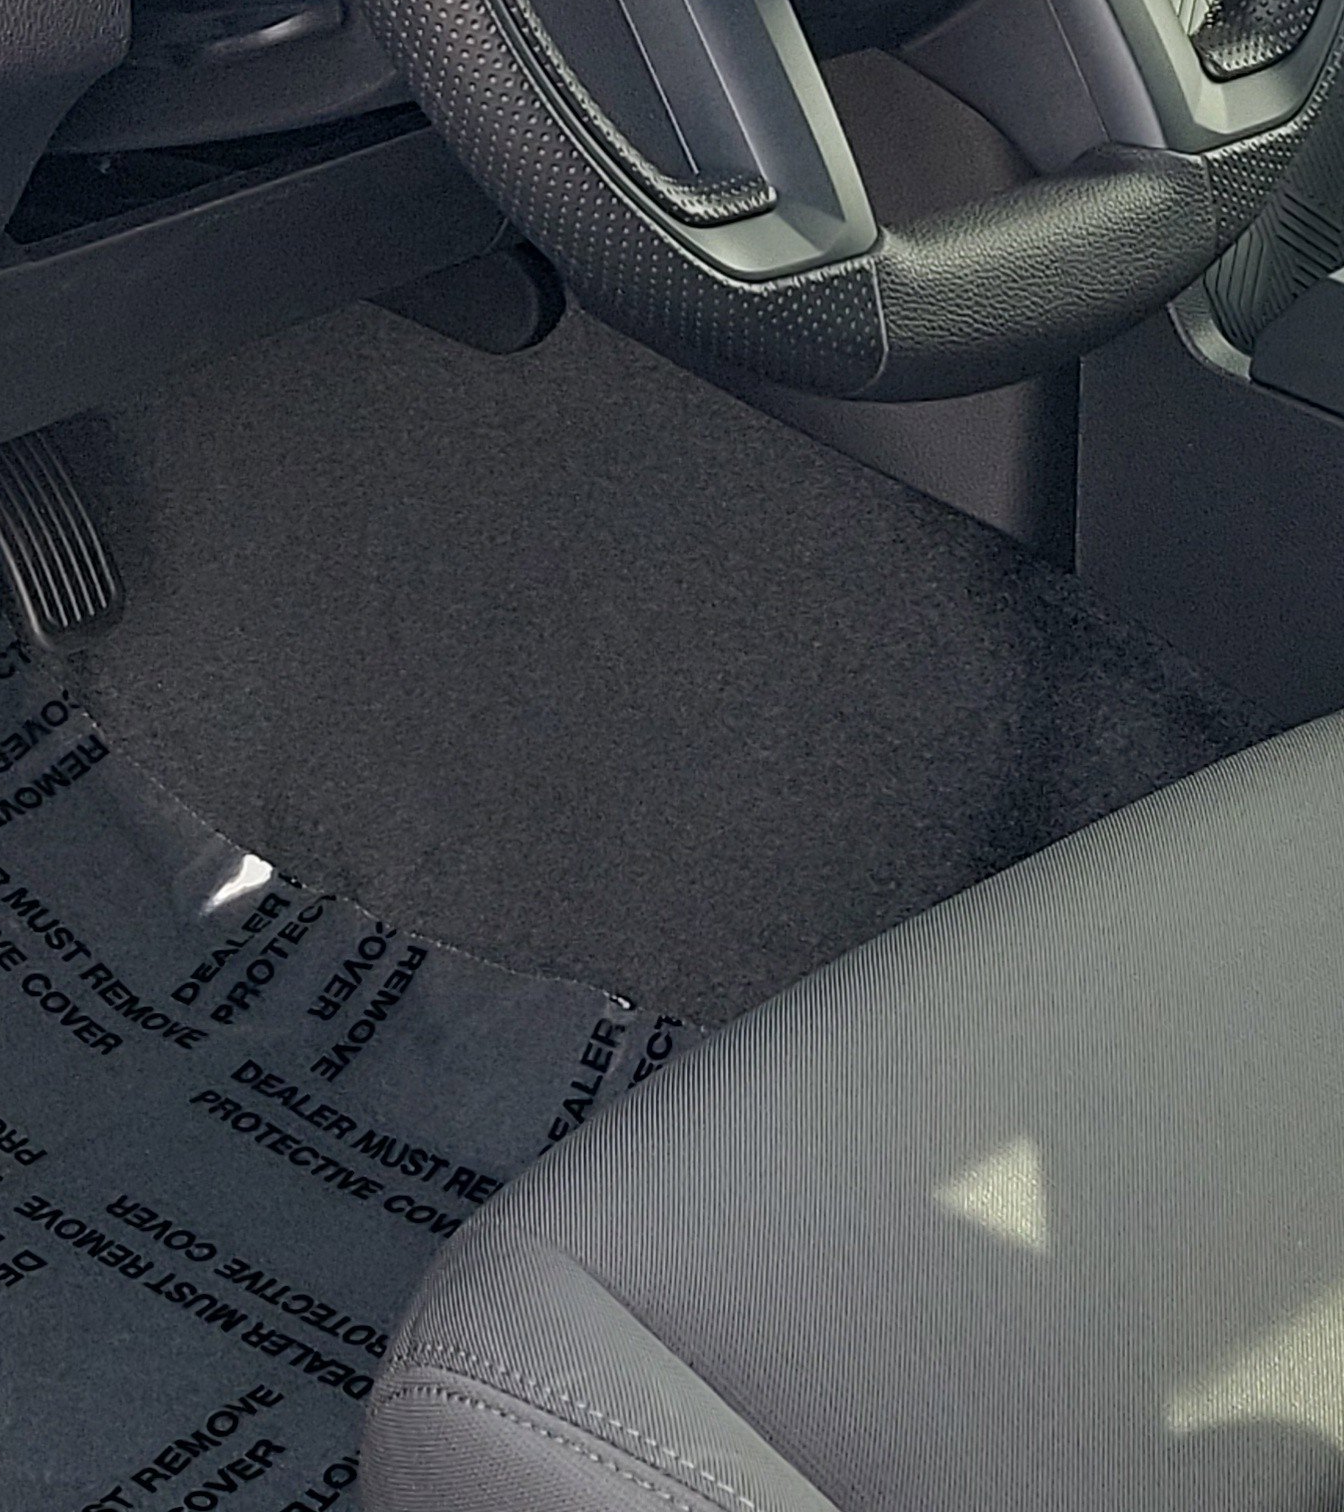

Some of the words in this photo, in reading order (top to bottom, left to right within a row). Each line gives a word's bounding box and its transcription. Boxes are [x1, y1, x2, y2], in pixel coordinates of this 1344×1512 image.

[1, 887, 93, 963] MUST
[80, 962, 210, 1050] REMOVE
[170, 892, 291, 1006] DEALER
[21, 972, 124, 1056] COVER
[310, 944, 429, 1083] REMOVE
[189, 1089, 386, 1202] PROTECTIVE
[230, 1059, 357, 1141] DEALER
[355, 1128, 450, 1185] MUST
[13, 1195, 155, 1279] REMOVE
[105, 1194, 217, 1263] COVER
[143, 1272, 248, 1333] MUST
[214, 1258, 389, 1359] ROTECTIVE
[241, 1321, 377, 1401] DEALER
[131, 1384, 286, 1492] REMOVE
[167, 1438, 286, 1512] OVER
